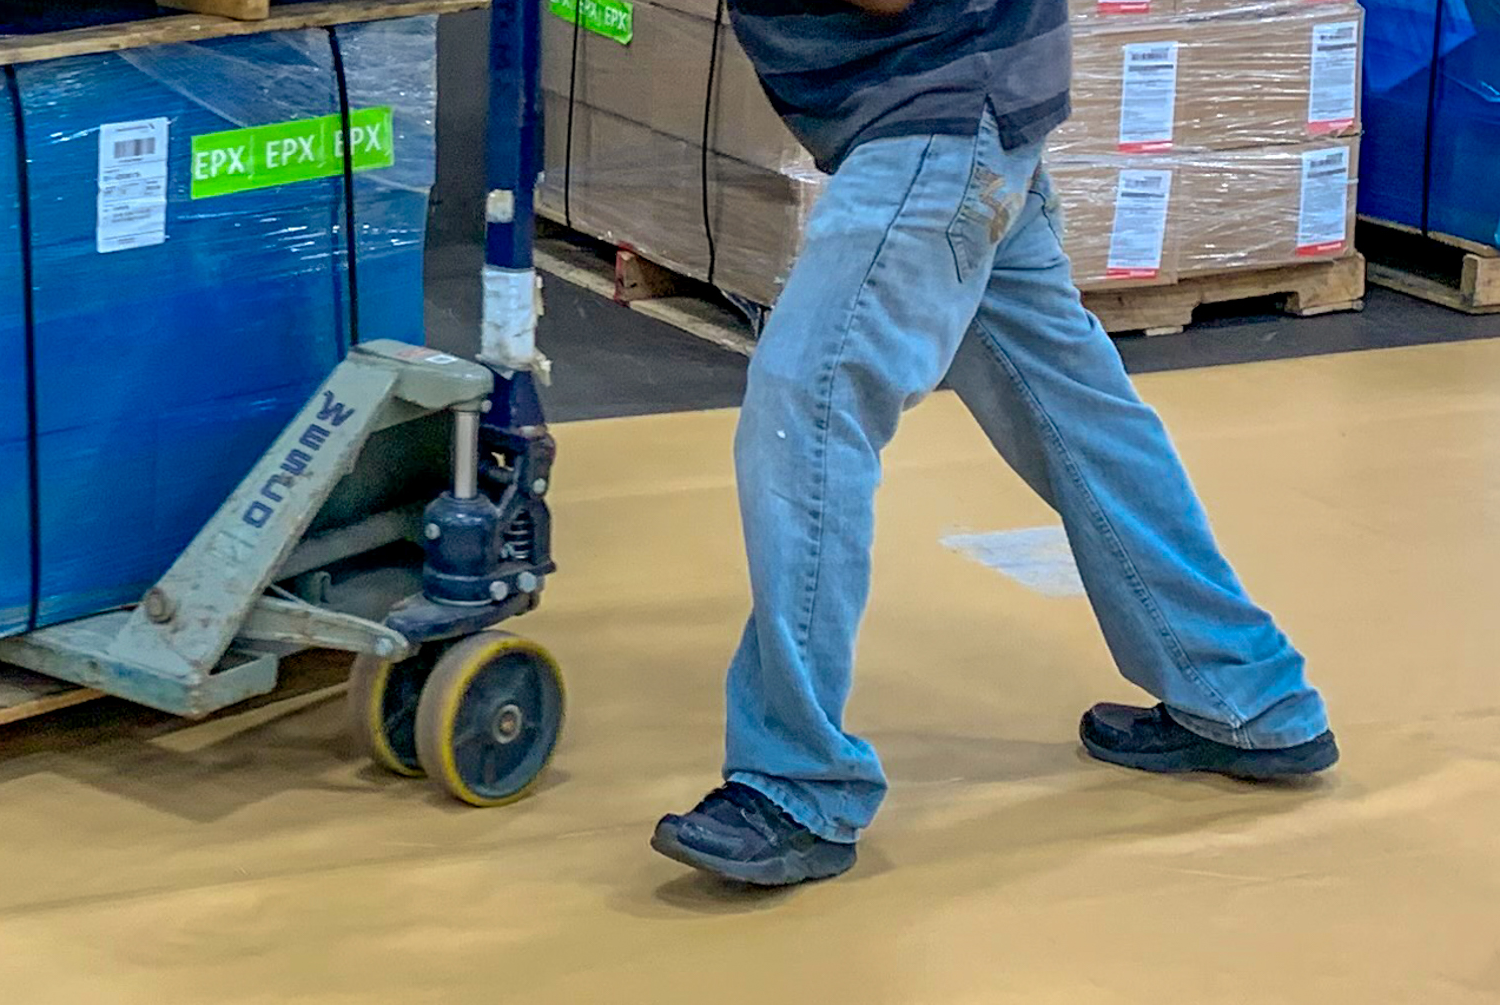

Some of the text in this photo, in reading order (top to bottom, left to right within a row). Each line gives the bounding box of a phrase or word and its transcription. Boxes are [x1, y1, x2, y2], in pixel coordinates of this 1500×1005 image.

[605, 6, 627, 31] EPX
[194, 145, 245, 180] EPX
[266, 134, 315, 169] EPX
[242, 390, 355, 528] WESCO
